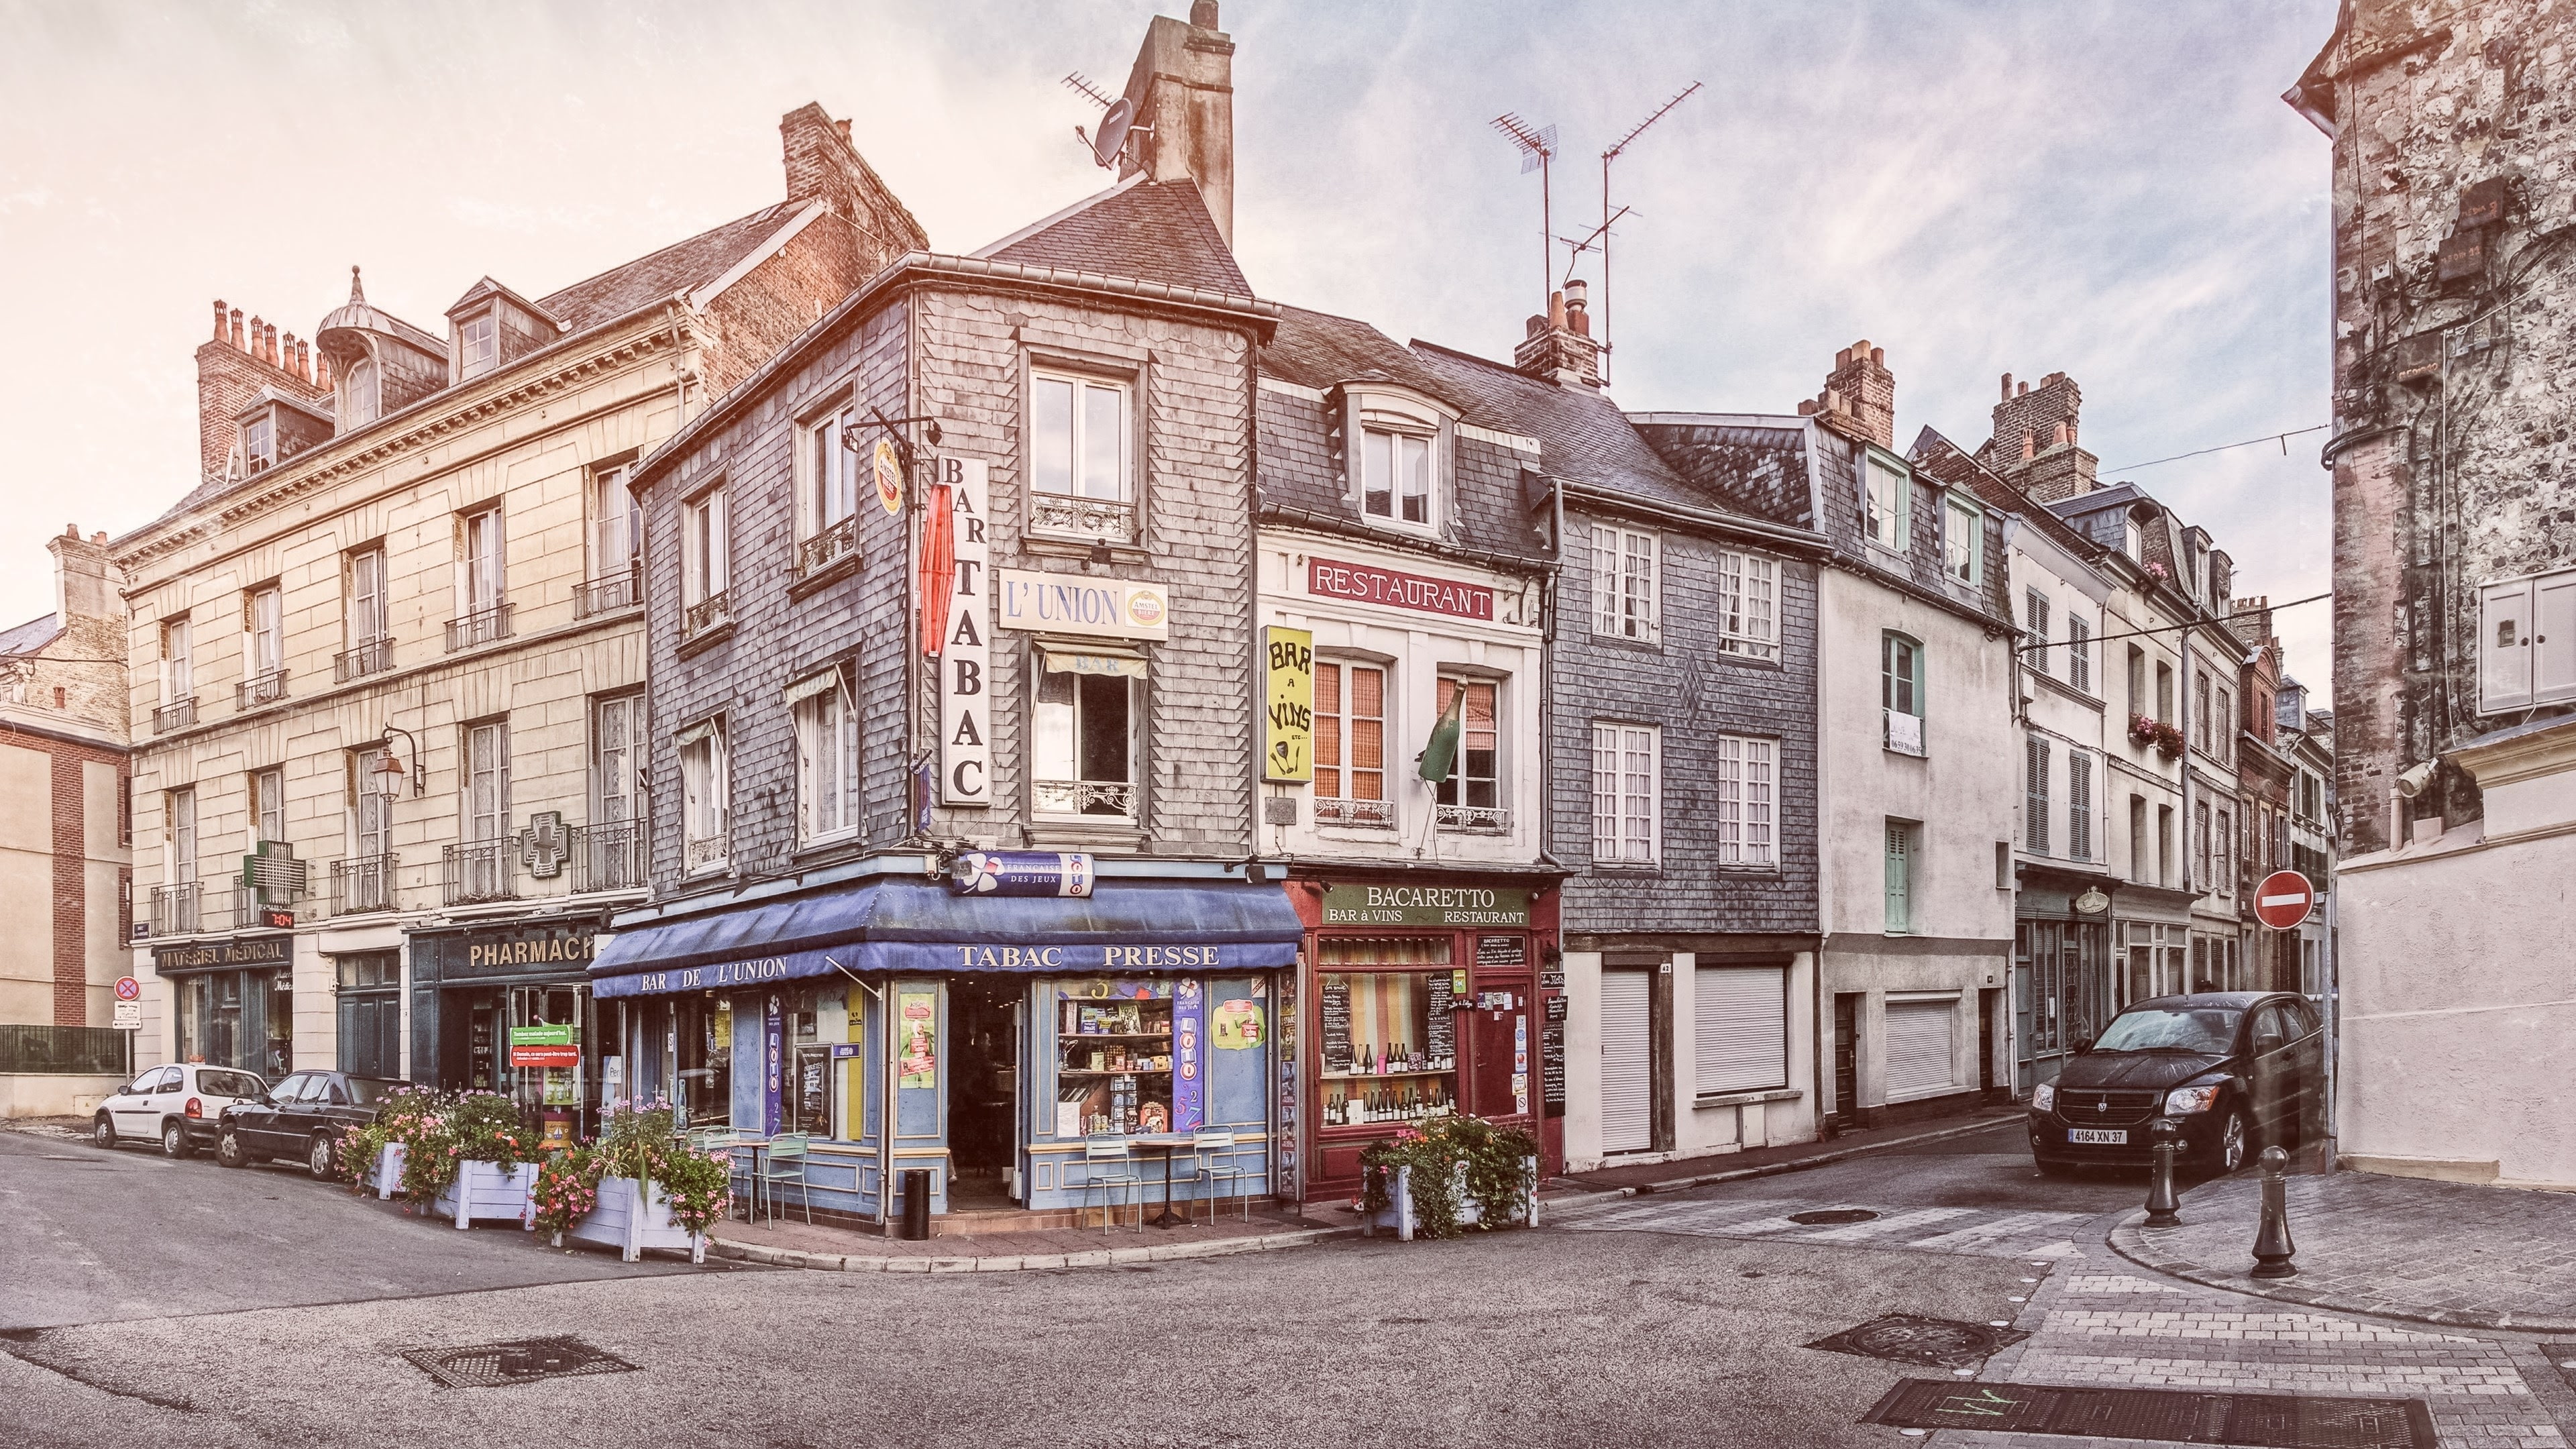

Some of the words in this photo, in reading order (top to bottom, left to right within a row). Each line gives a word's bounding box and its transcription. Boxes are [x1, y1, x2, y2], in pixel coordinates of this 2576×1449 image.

[943, 459, 987, 544] BAR
[1316, 566, 1490, 615] RESTAURANT
[1134, 602, 1159, 610] AMSTEL
[1076, 655, 1119, 672] BAR
[1269, 641, 1311, 675] BAR
[951, 559, 983, 796] TABAC
[1269, 694, 1311, 732] VINS
[1032, 875, 1057, 883] JEUX
[1070, 855, 1083, 895] LOTO
[1366, 887, 1495, 908] BACARETTO
[272, 914, 291, 926] 7:04
[1329, 909, 1357, 921] BAR
[1361, 910, 1368, 921] à
[1372, 910, 1403, 922] VINS
[1444, 911, 1524, 923] RESTAURANT
[470, 937, 594, 967] PHARMACI
[957, 946, 1062, 967] TABAC
[1103, 946, 1220, 967] PRESSE
[641, 973, 666, 991] BAR
[682, 969, 701, 987] DE
[718, 957, 788, 983] L'UNION
[1091, 981, 1108, 999] 3
[1179, 1017, 1197, 1081] LOTO
[769, 1033, 779, 1092] LOTO
[1175, 1097, 1187, 1114] 5
[1190, 1090, 1197, 1102] 2
[1185, 1106, 1201, 1126] 7
[2075, 1131, 2095, 1142] 4164
[2097, 1131, 2110, 1142] XN
[2112, 1132, 2123, 1142] 37
